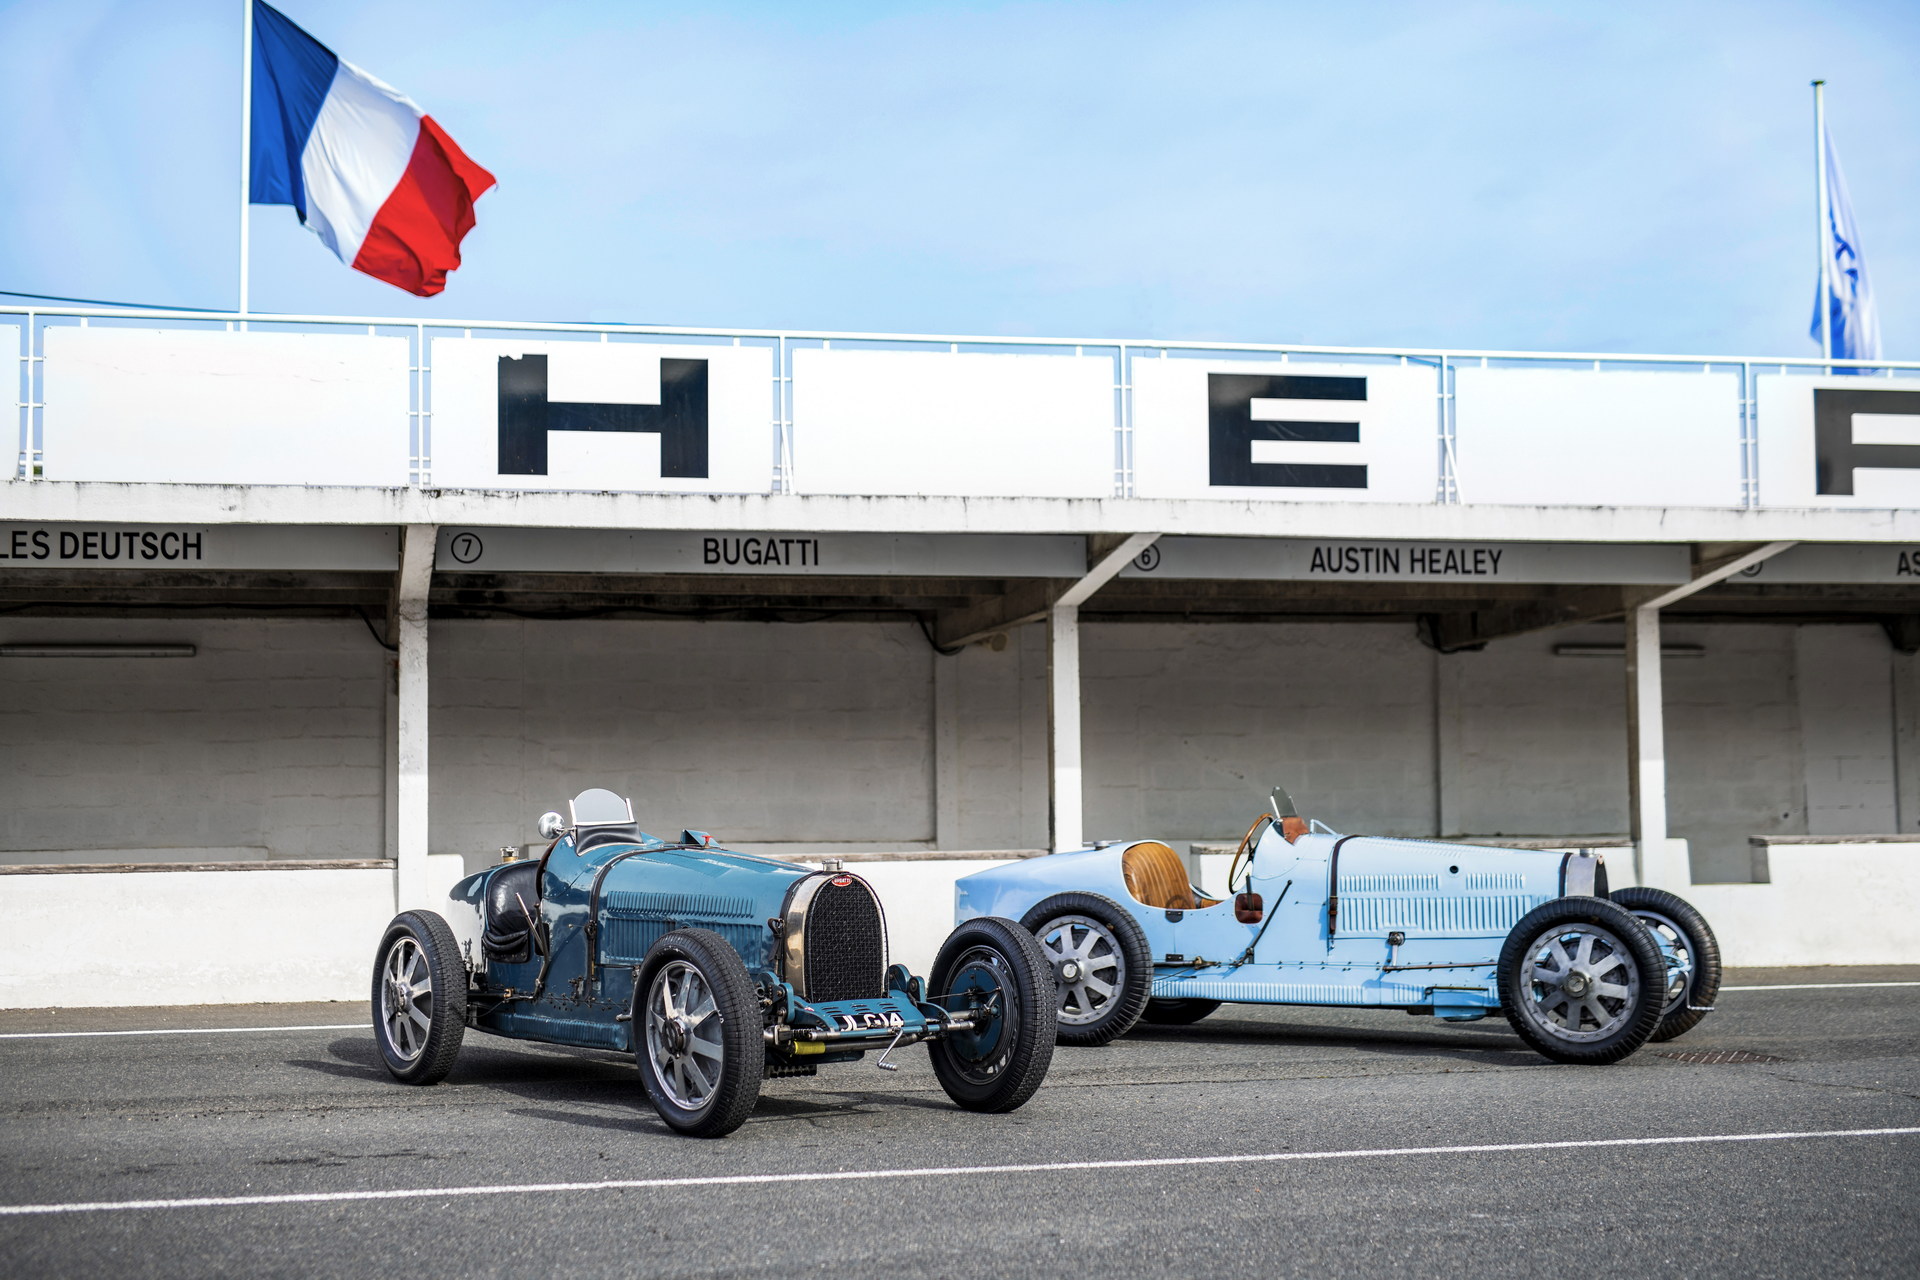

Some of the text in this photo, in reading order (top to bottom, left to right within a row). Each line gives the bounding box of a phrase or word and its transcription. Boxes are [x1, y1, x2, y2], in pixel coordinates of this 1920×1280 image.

[498, 354, 708, 478] H
[1208, 373, 1367, 488] E
[60, 532, 202, 560] DEUTSCH
[703, 537, 819, 566] BUGATTI
[1310, 546, 1400, 575] AUSTIN
[1409, 547, 1503, 575] HEALEY
